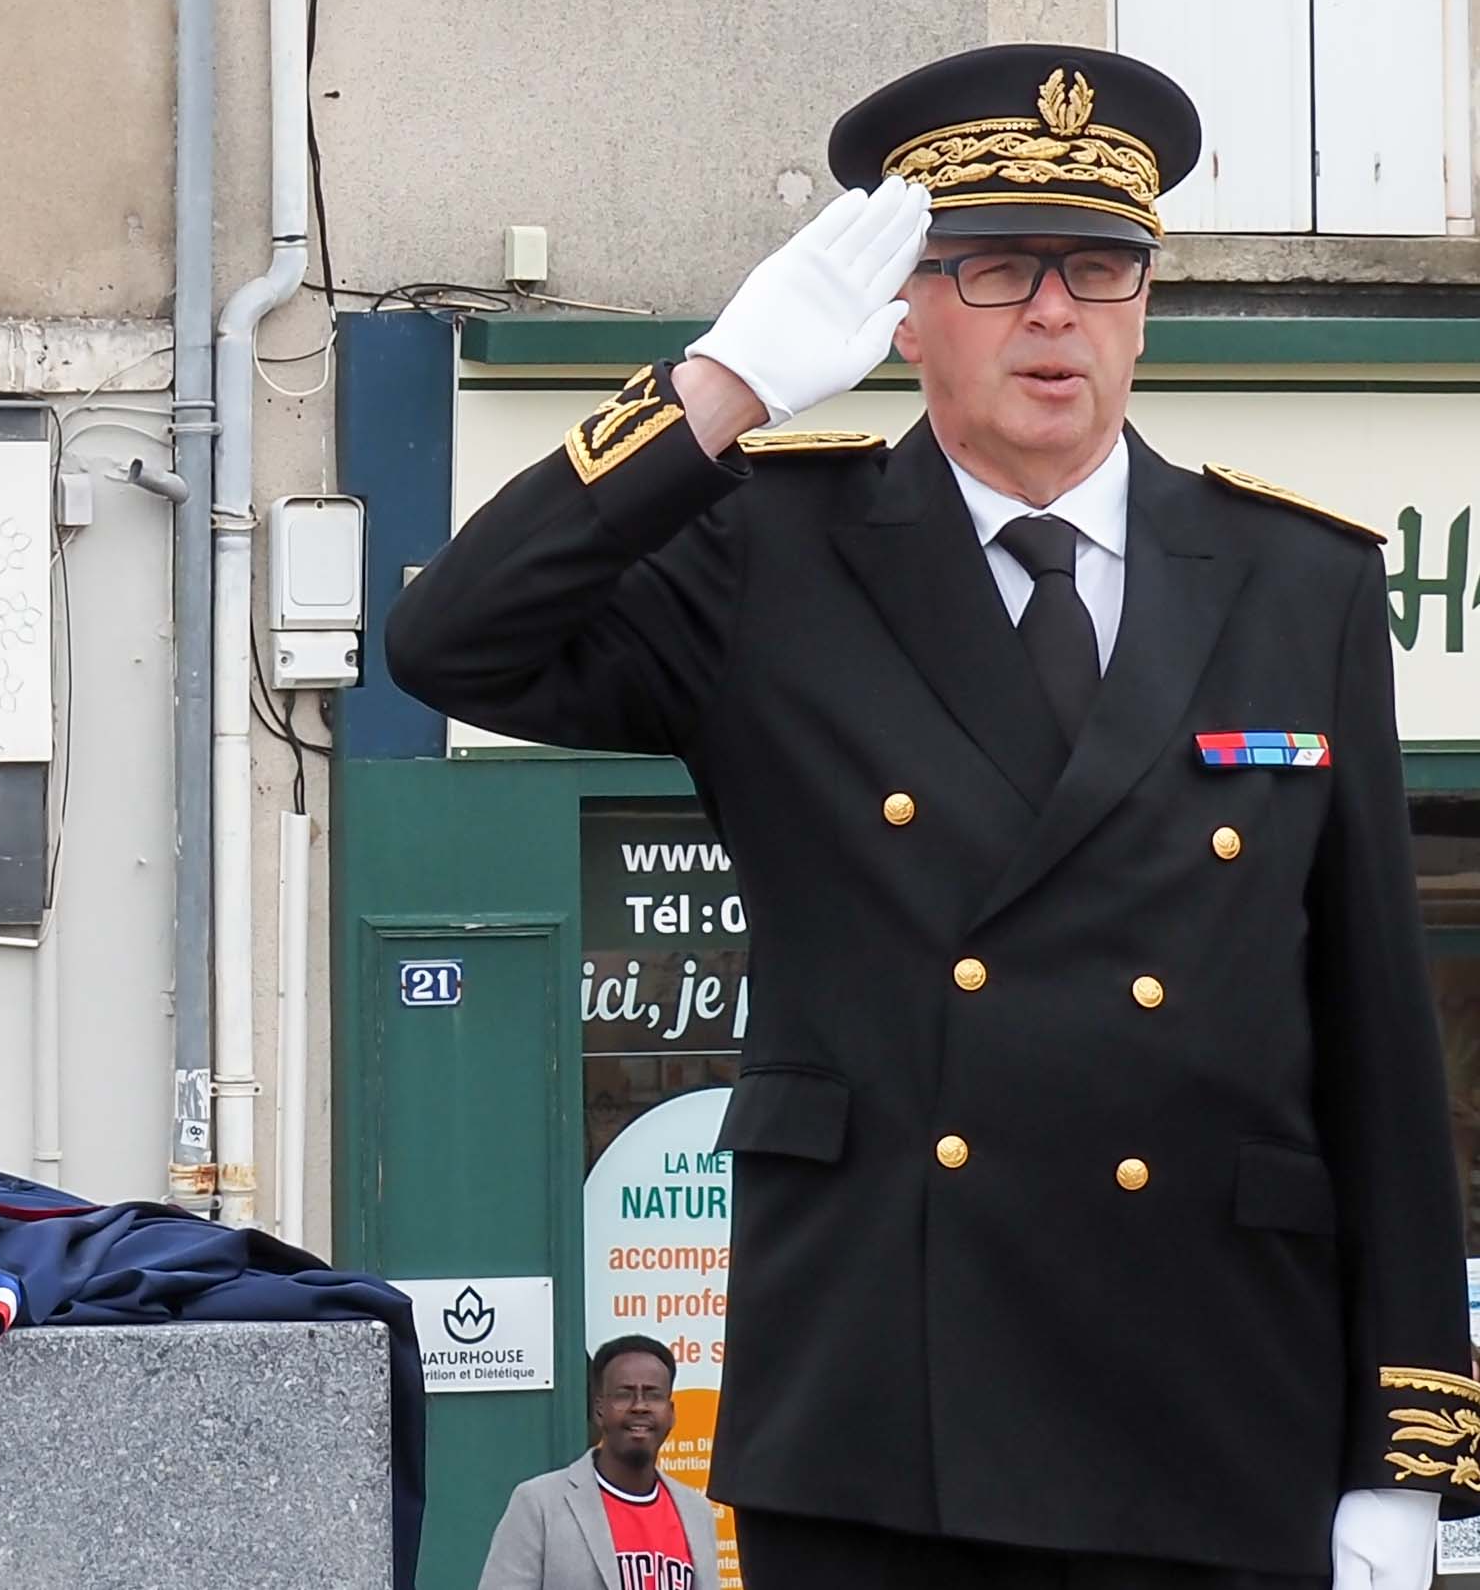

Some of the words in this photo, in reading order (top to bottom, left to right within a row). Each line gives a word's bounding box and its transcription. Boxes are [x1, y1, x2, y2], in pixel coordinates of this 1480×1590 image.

[1387, 505, 1480, 653] H
[411, 969, 450, 1000] 21
[662, 959, 725, 1039] je
[664, 1152, 689, 1174] LA
[621, 1185, 727, 1219] NATUR
[613, 1292, 647, 1317] un
[656, 1288, 727, 1323] profe
[460, 1369, 471, 1380] et
